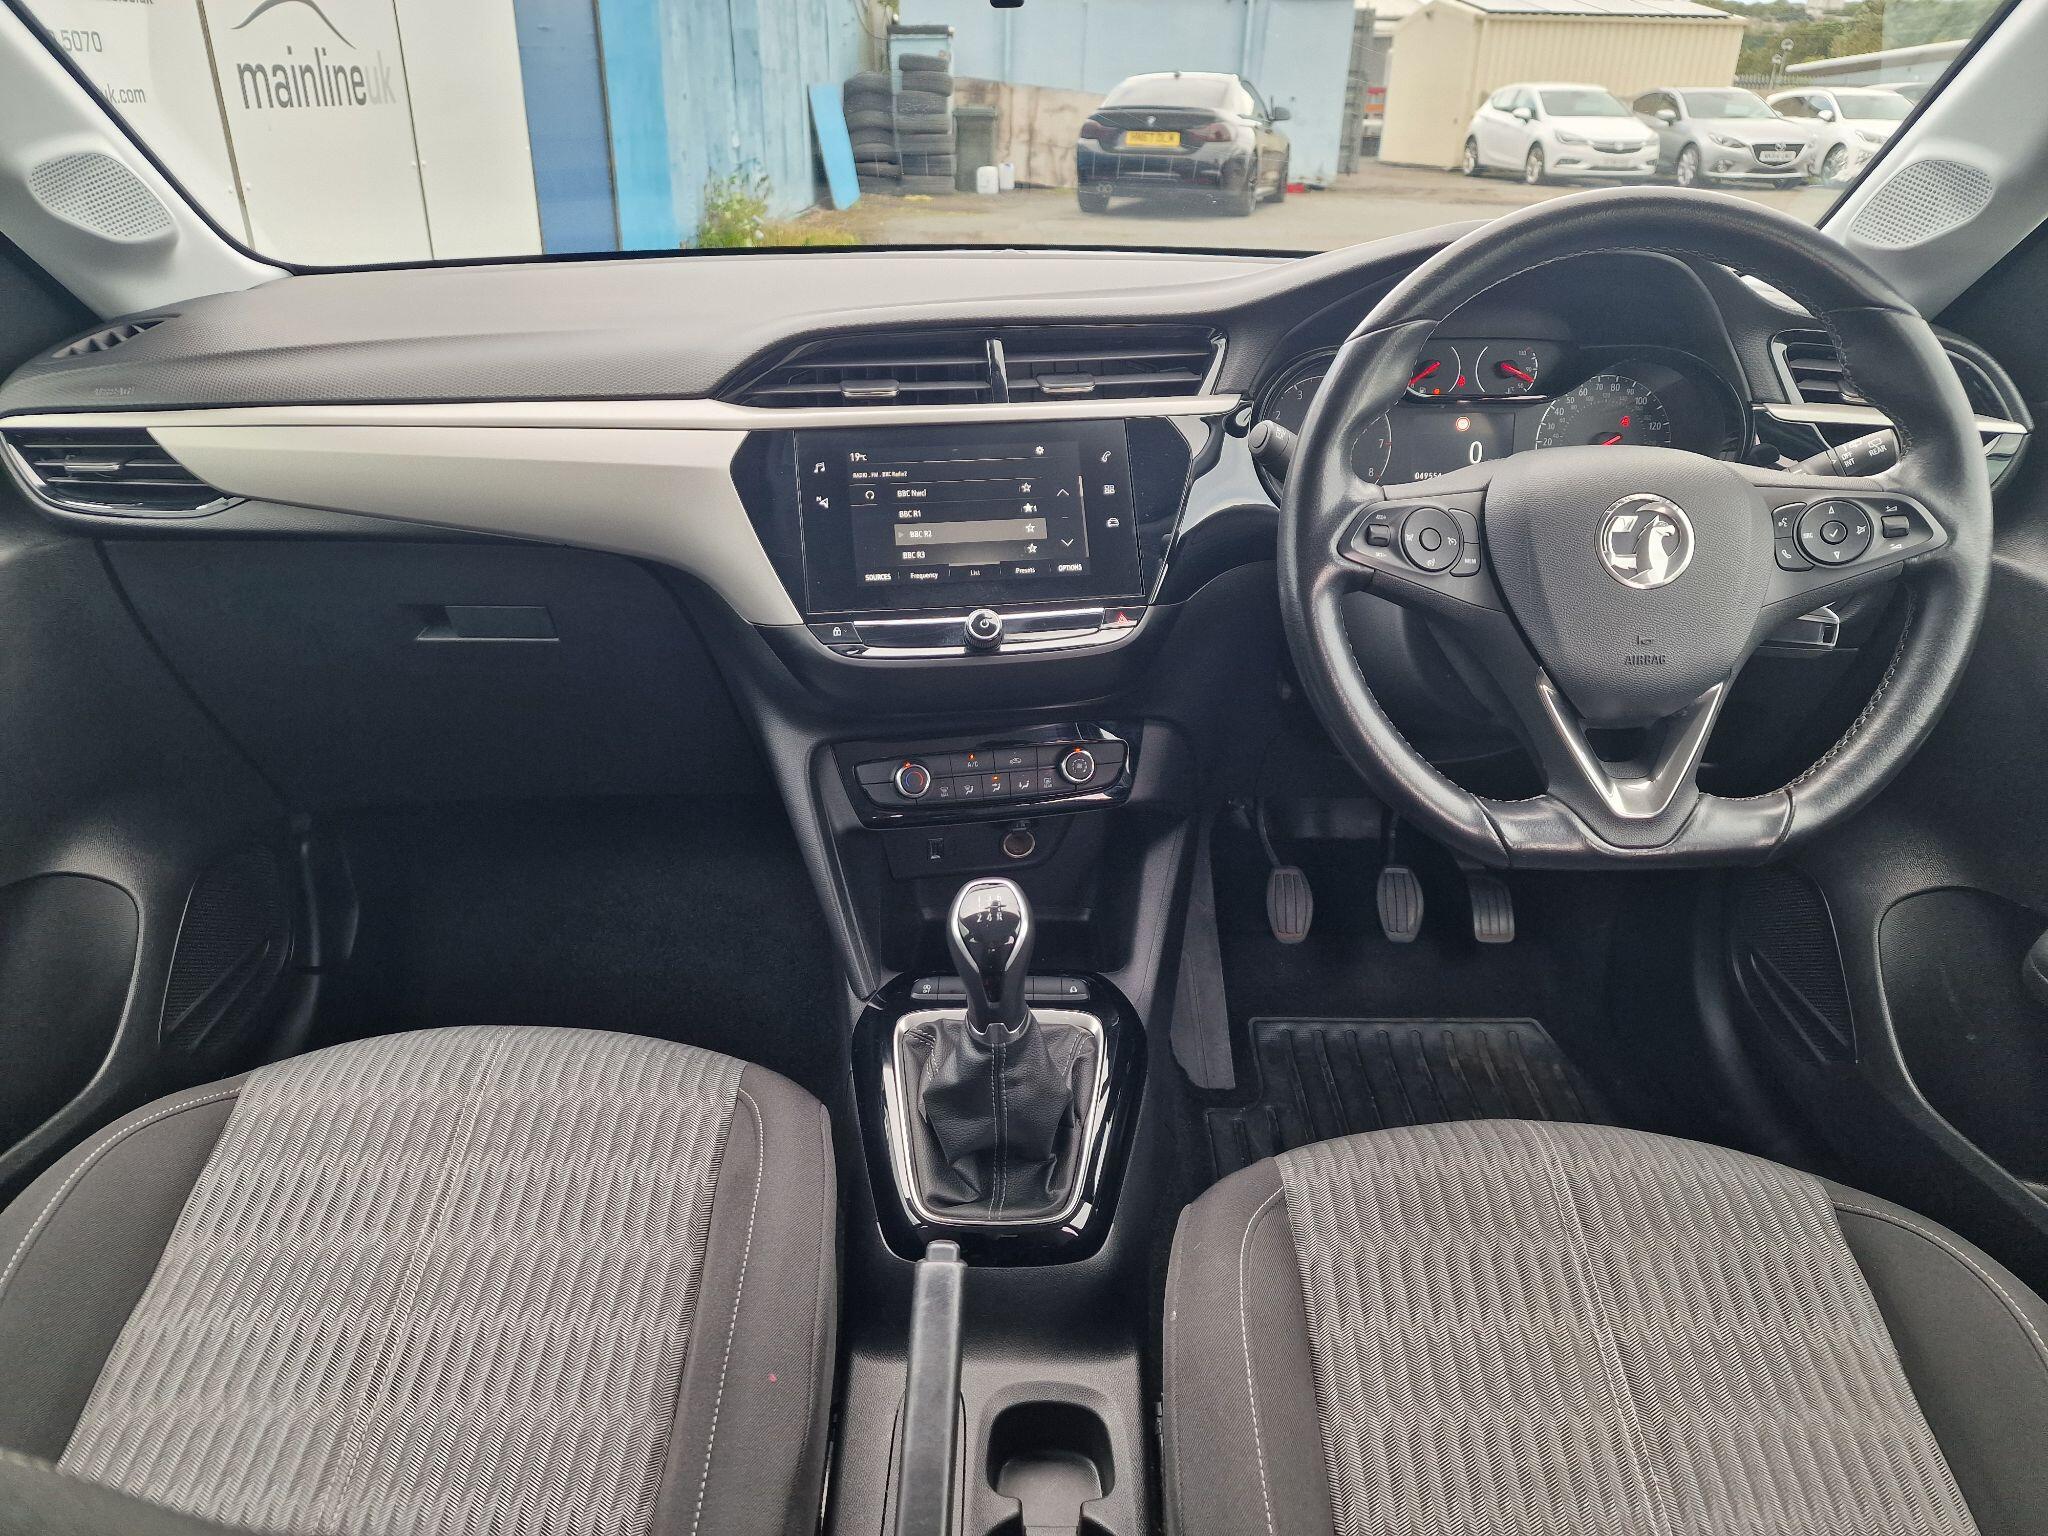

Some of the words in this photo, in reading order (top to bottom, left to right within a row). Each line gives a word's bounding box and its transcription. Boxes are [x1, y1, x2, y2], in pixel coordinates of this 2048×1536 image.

[236, 45, 397, 109] mainlineuk
[1595, 383, 1604, 391] 70
[1610, 383, 1621, 392] 80
[1297, 390, 1303, 400] 3
[1578, 388, 1588, 396] 60
[1566, 396, 1575, 404] 50
[1635, 397, 1648, 405] 100
[1275, 410, 1281, 420] 2
[1554, 407, 1565, 415] 40
[1649, 421, 1662, 430] 120
[1378, 439, 1385, 449] 7
[1542, 438, 1553, 446] 20
[1469, 440, 1483, 464] 0
[1868, 444, 1887, 457] REAR
[1843, 457, 1855, 468] INT
[1368, 467, 1374, 477] 8
[897, 489, 911, 498] BBC
[898, 510, 912, 518] BBC
[913, 509, 921, 518] R1
[909, 530, 923, 538] BBC
[923, 530, 933, 538] R2
[902, 551, 916, 560] BBC
[917, 551, 926, 559] R3
[1015, 566, 1036, 574] Presets
[1058, 563, 1083, 572] OPTIONS
[864, 572, 892, 581] SOURCES
[910, 571, 938, 581] Frequency
[1625, 654, 1666, 666] AIRBAG
